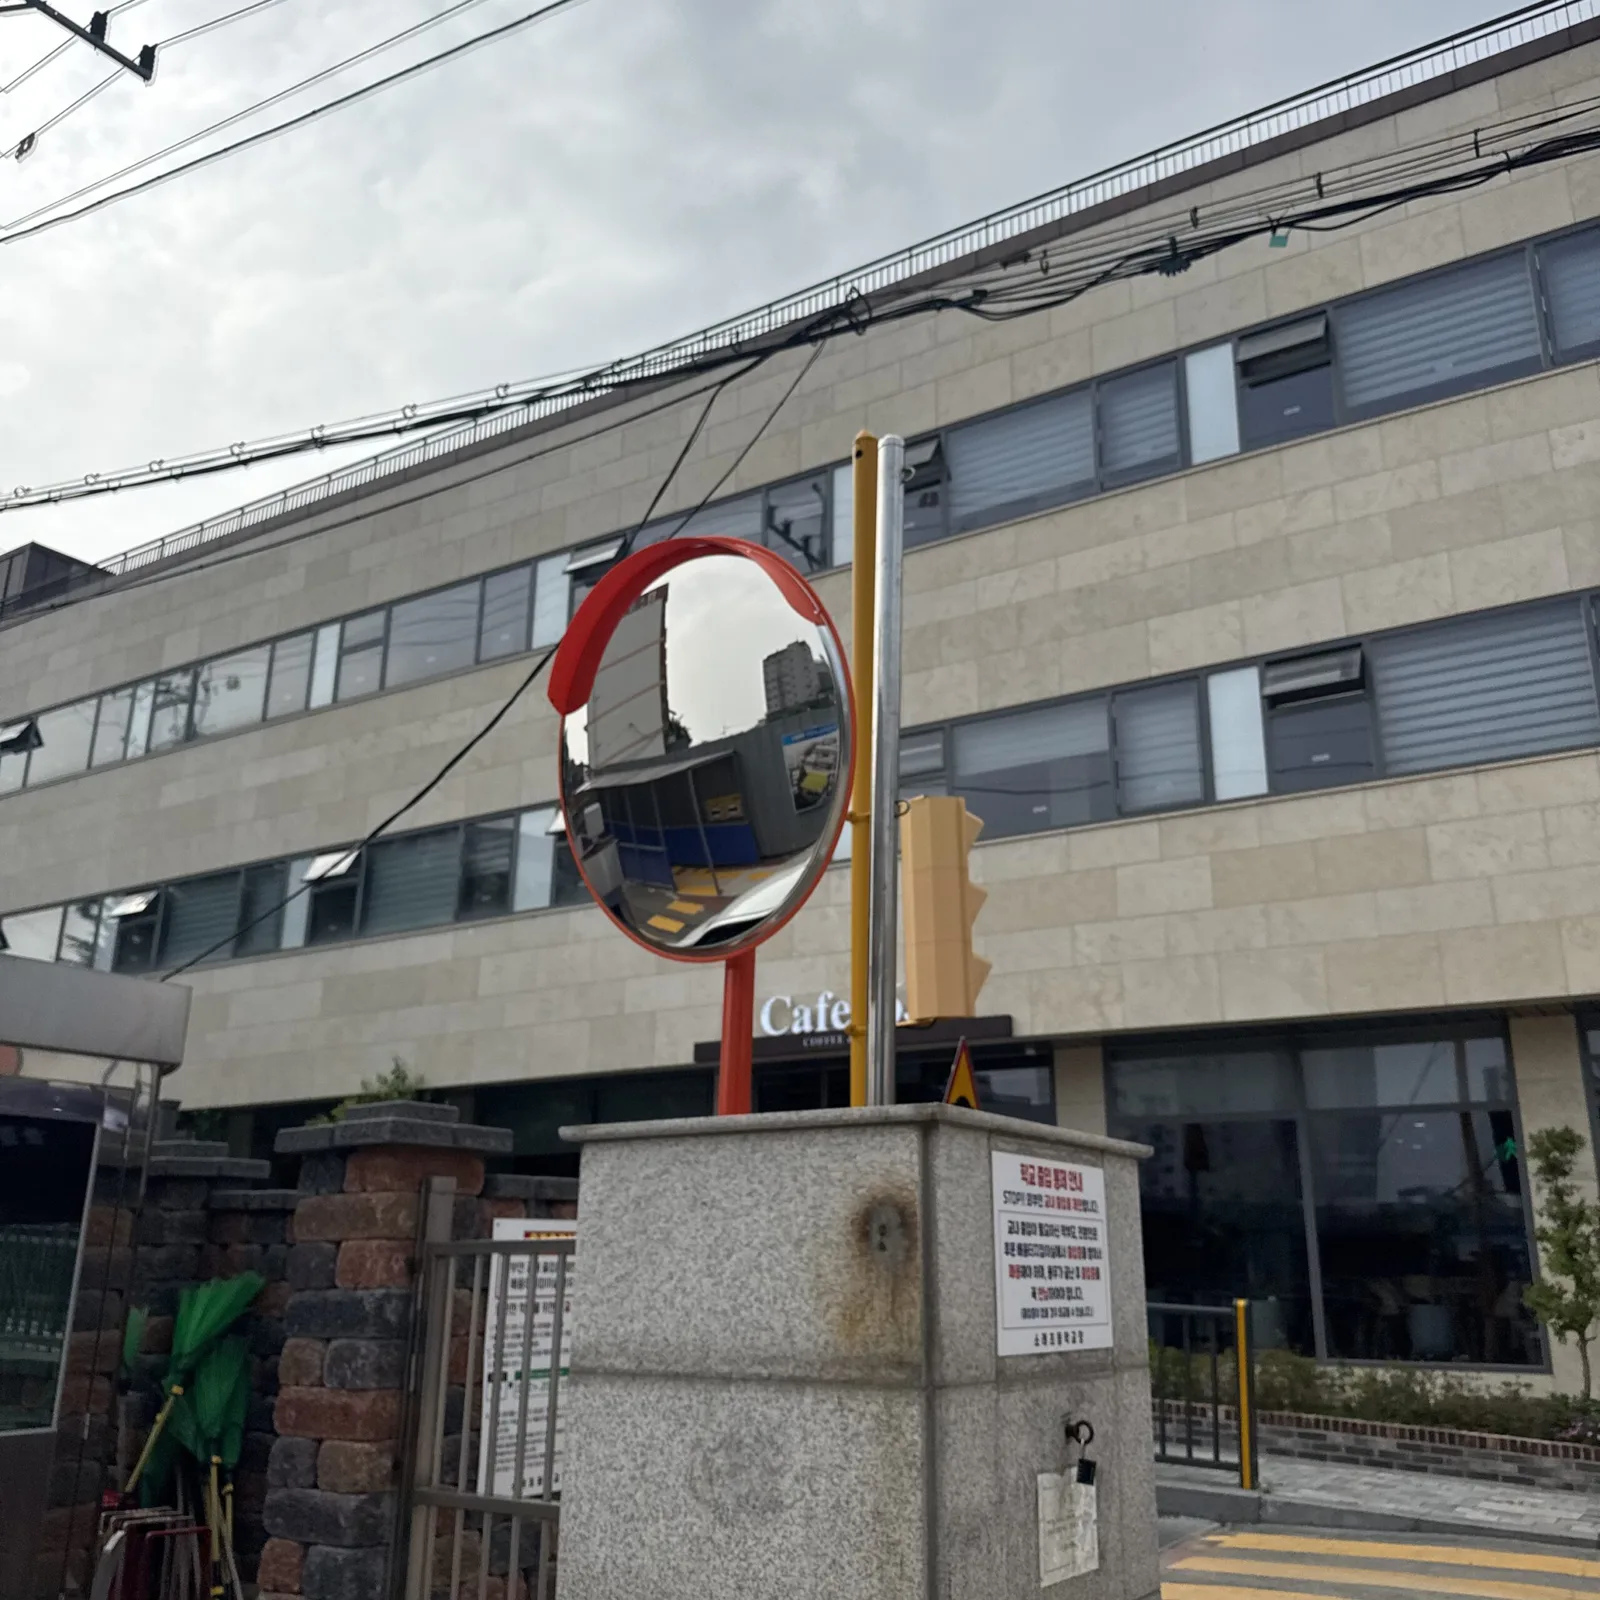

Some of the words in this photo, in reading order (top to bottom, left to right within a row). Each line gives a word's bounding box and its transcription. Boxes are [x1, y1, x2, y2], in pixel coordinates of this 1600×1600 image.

[760, 990, 851, 1036] Cafe
[1020, 1163, 1035, 1186] 학교
[1037, 1165, 1051, 1187] 출입
[1053, 1168, 1067, 1189] 통제
[1068, 1170, 1082, 1191] 안내
[1026, 1192, 1042, 1207] 외부인
[1044, 1194, 1054, 1208] 교내
[1007, 1219, 1019, 1235] 교내
